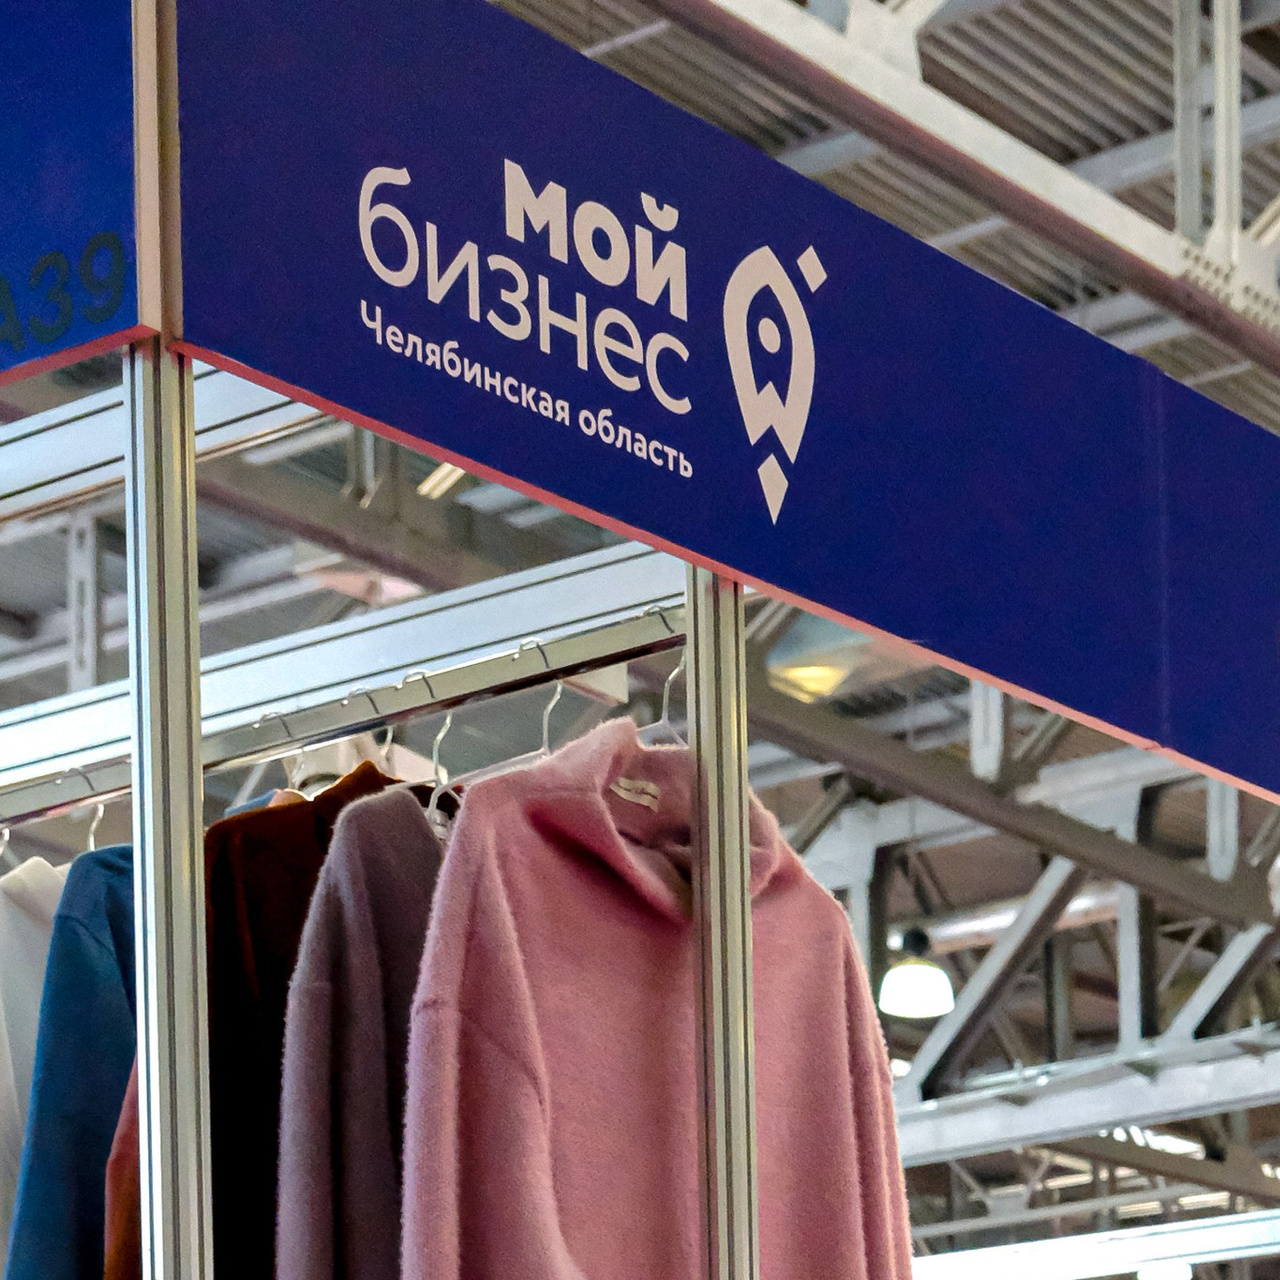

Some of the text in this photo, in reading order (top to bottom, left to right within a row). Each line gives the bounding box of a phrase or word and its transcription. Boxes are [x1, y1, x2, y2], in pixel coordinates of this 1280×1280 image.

[358, 166, 692, 415] бизнес
[360, 299, 693, 478] Челябинская область
